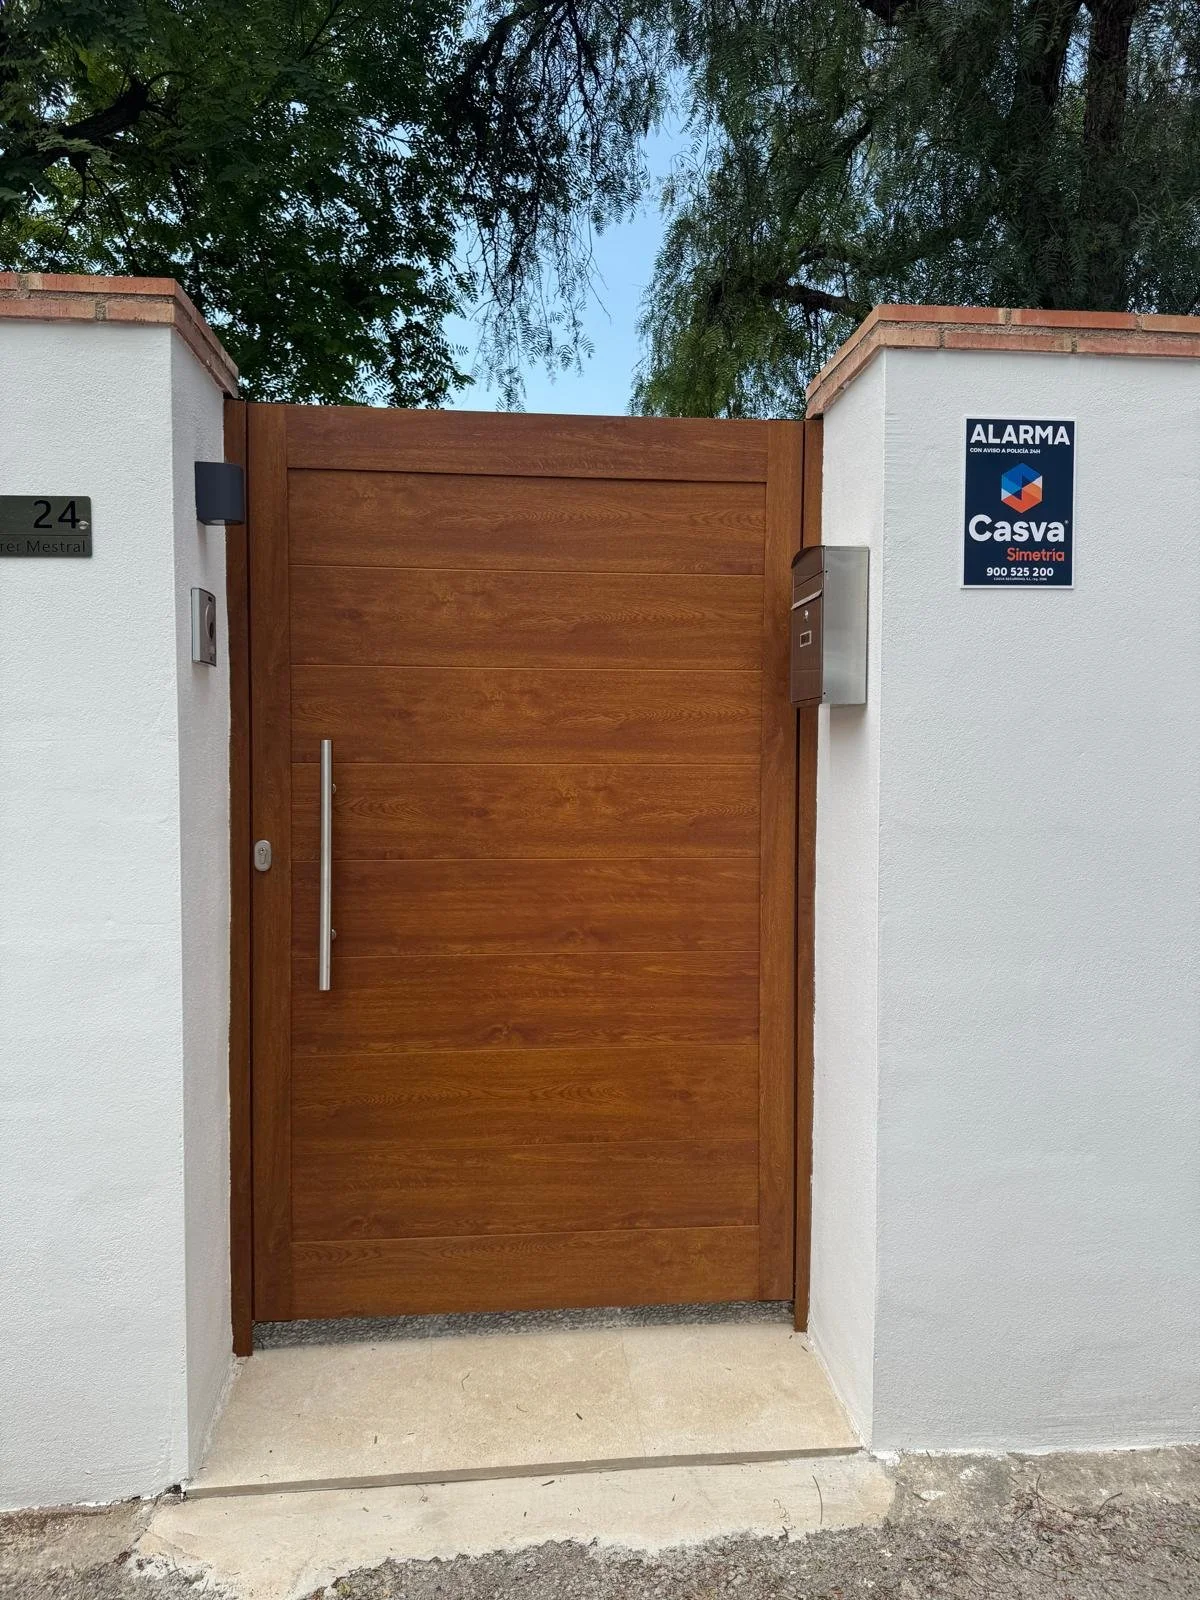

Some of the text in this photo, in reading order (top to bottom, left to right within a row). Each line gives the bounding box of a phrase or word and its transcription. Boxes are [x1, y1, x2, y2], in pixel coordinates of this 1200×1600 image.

[969, 424, 1071, 445] ALARMA
[33, 500, 80, 528] 24
[968, 514, 1065, 542] Casva
[27, 540, 85, 553] Mestral
[1006, 547, 1065, 562] Simetría
[986, 567, 1054, 577] 900 525 200
